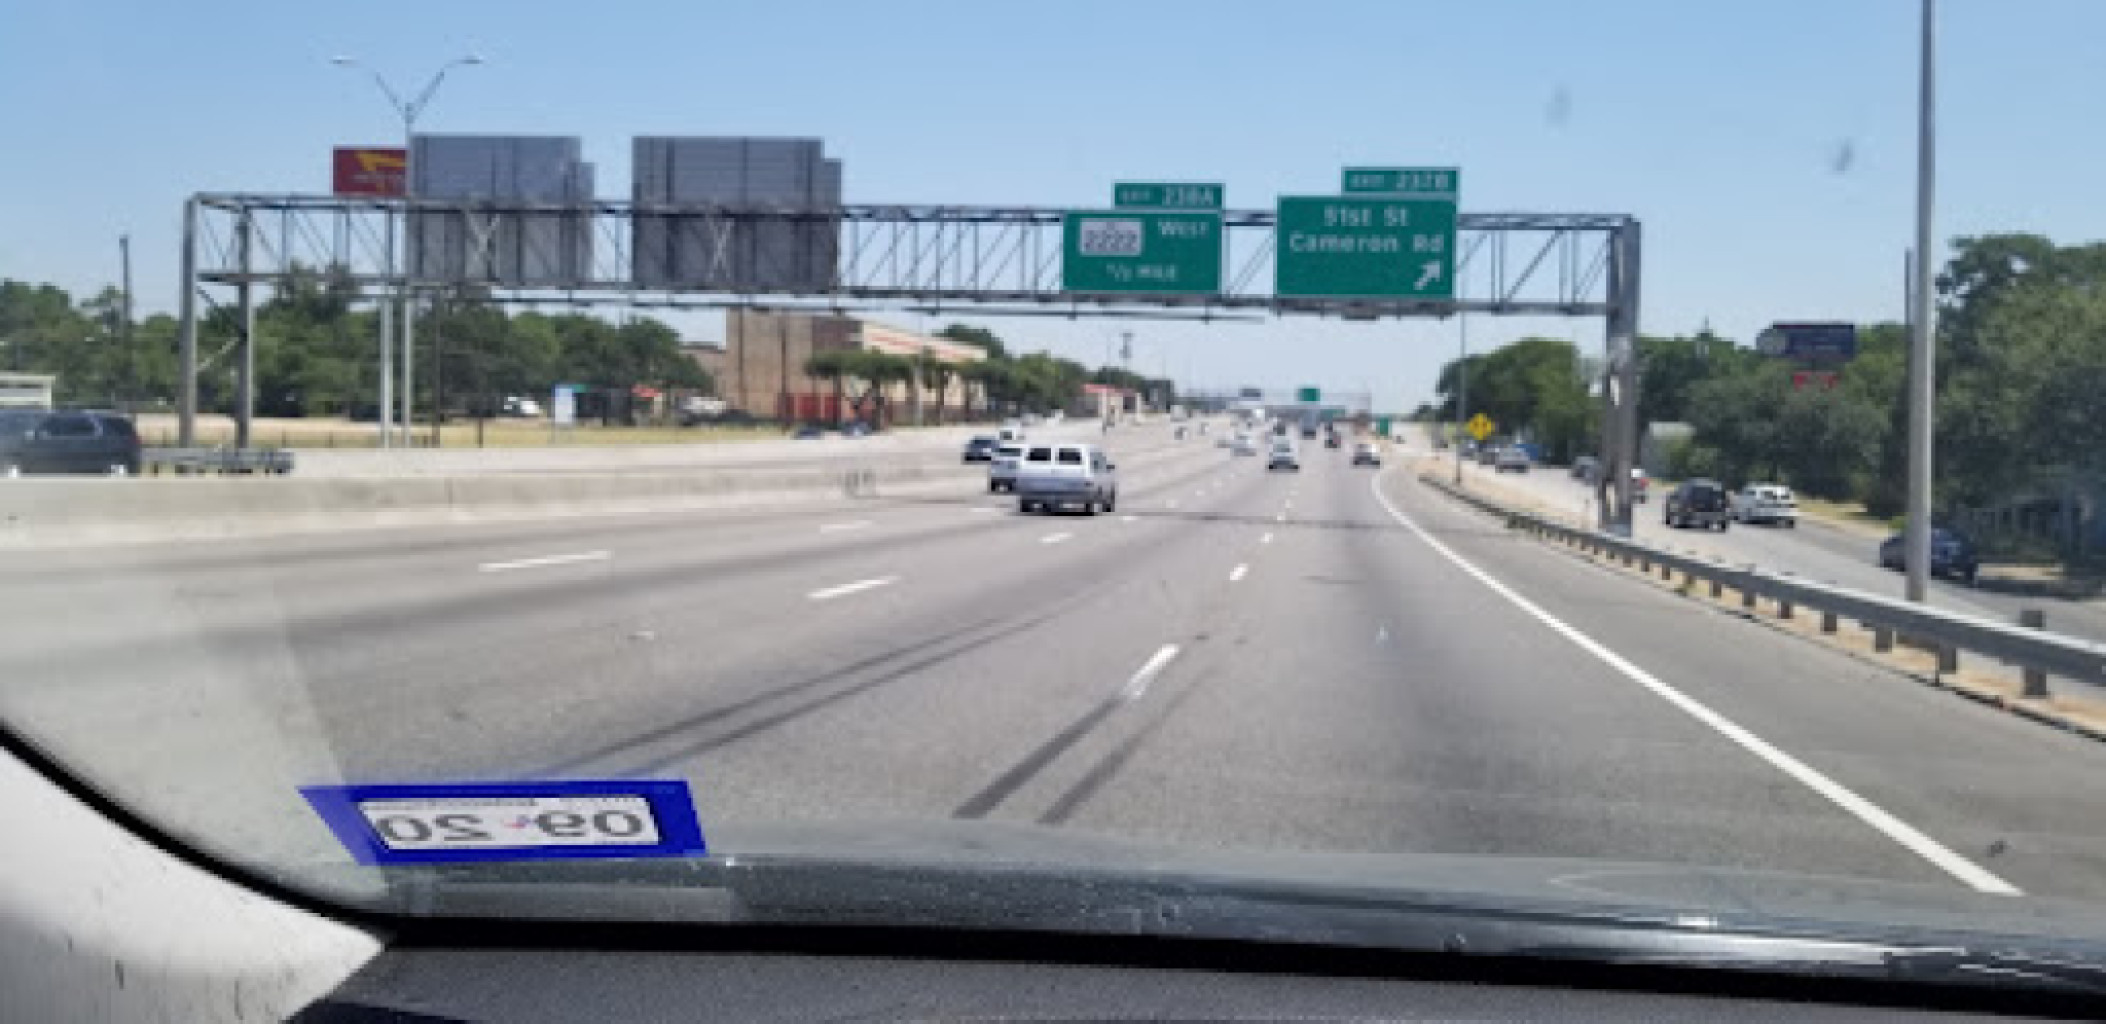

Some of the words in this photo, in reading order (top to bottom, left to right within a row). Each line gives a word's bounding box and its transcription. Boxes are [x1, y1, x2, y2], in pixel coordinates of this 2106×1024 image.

[1323, 205, 1372, 227] 51st
[1383, 205, 1409, 227] St
[1084, 229, 1139, 251] 2222
[1288, 233, 1398, 253] Cameron
[1412, 232, 1445, 253] Rd
